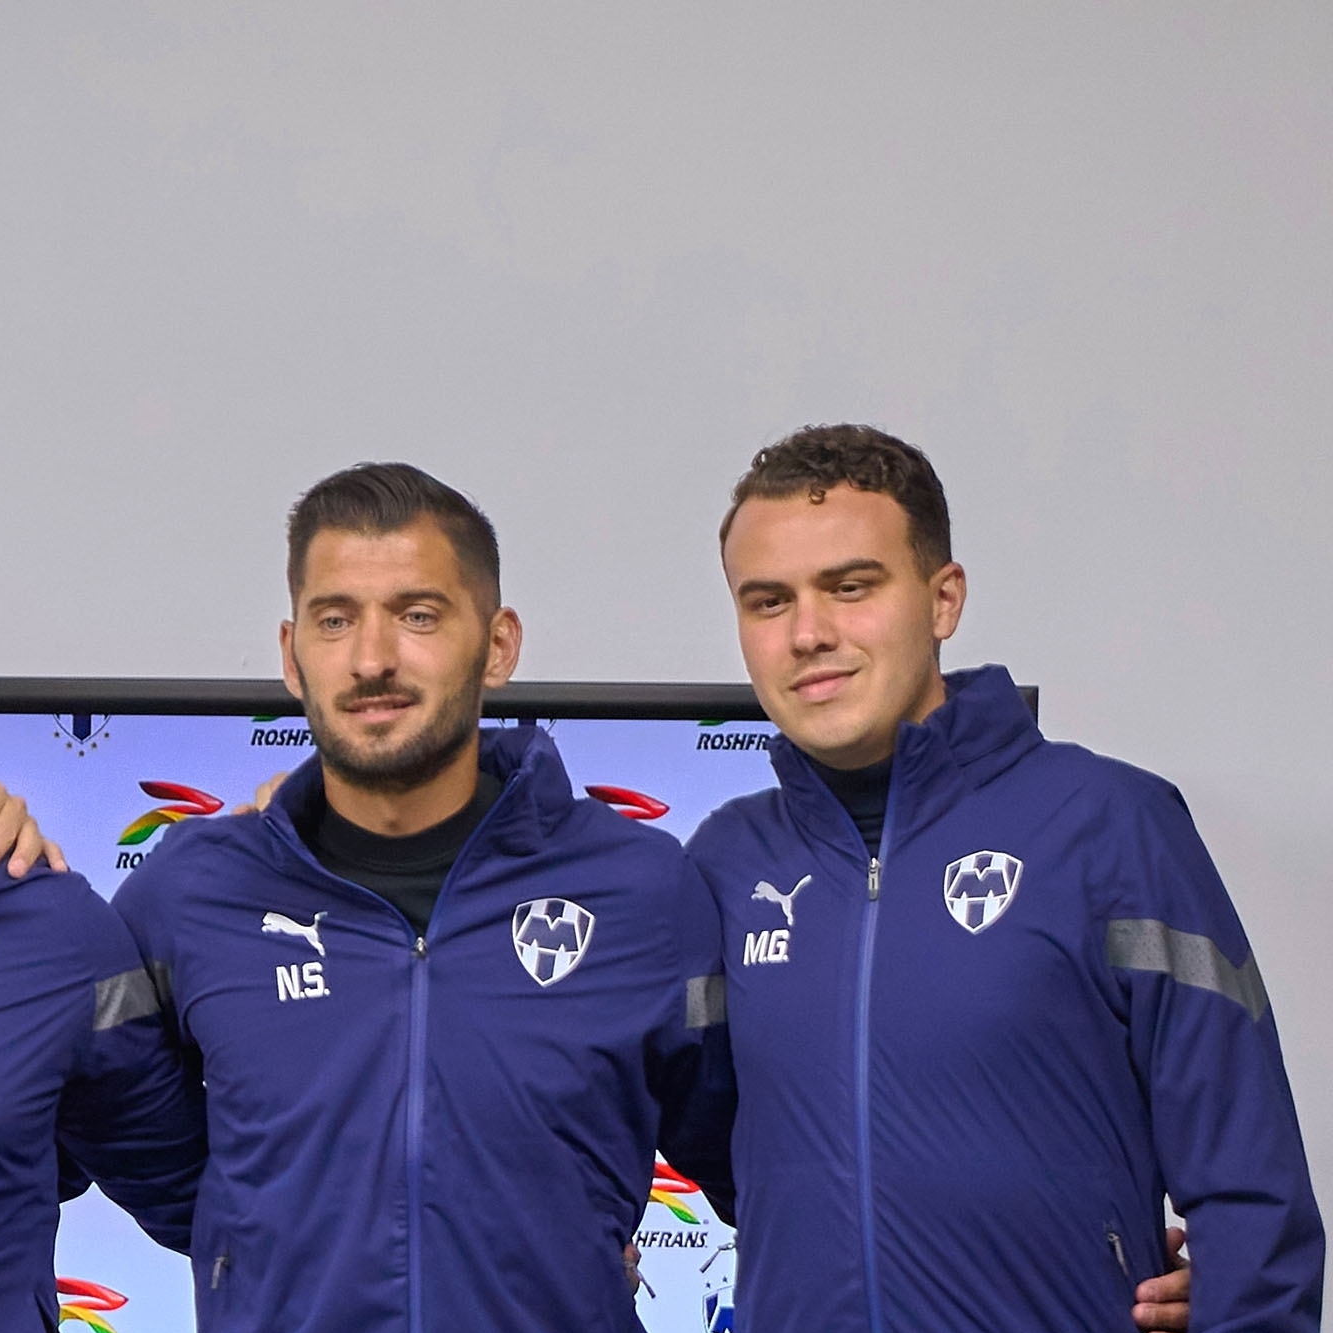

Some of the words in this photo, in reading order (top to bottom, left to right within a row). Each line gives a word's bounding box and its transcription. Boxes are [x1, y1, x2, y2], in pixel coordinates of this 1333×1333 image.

[251, 729, 314, 746] ROSHF
[696, 733, 770, 750] ROSHFR
[743, 929, 790, 966] M.G.
[276, 961, 331, 1002] N.S.
